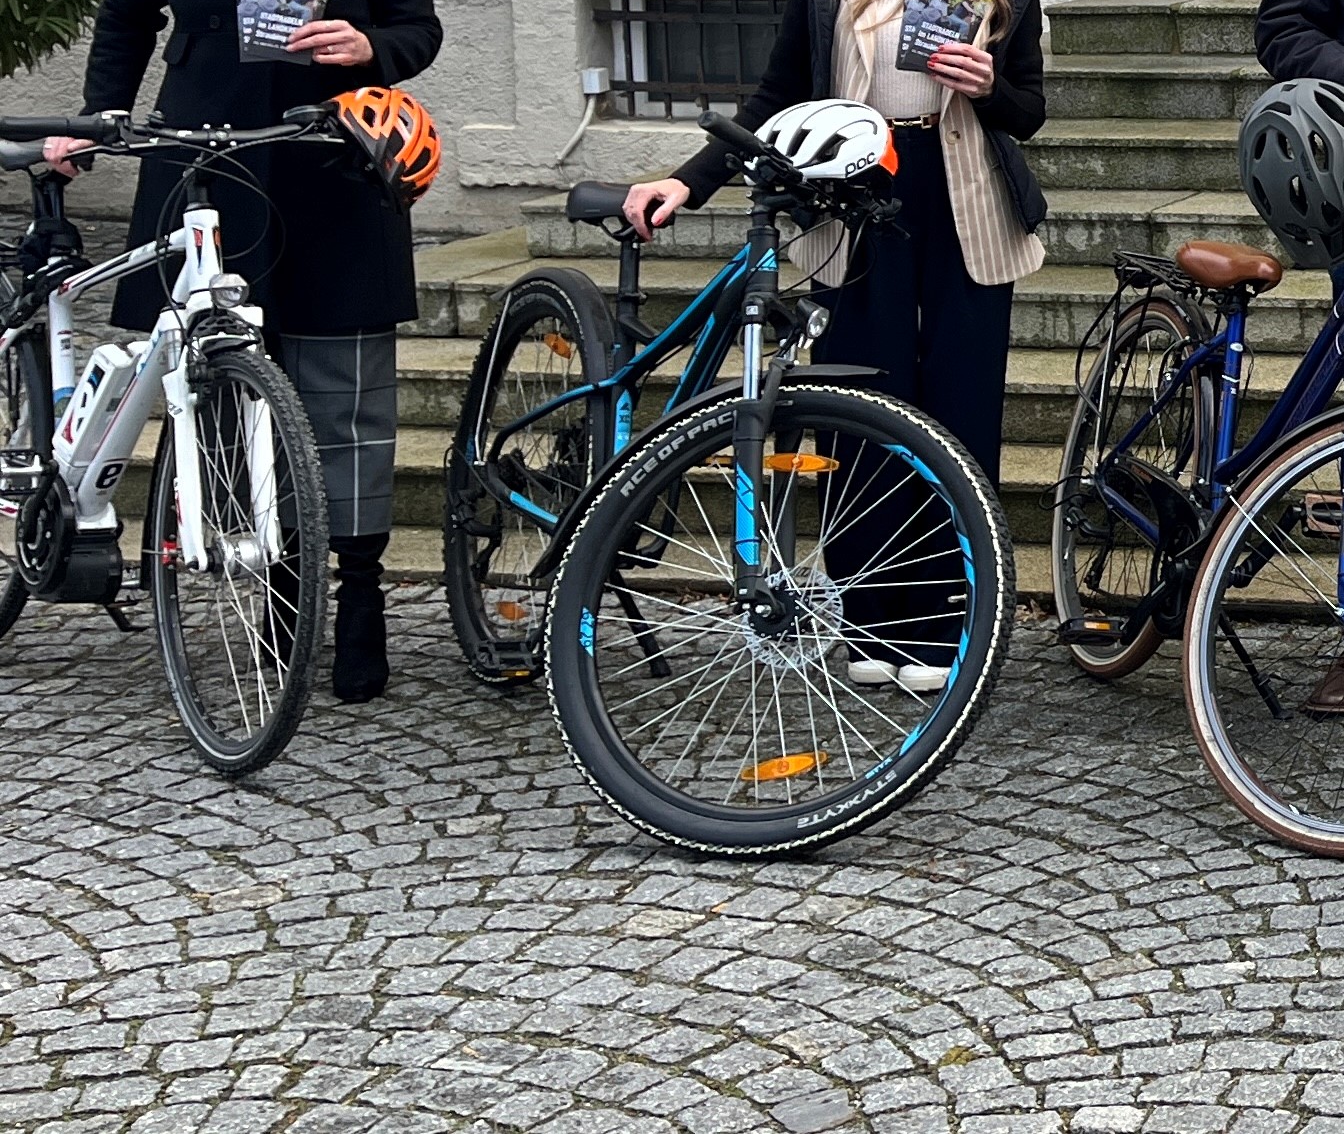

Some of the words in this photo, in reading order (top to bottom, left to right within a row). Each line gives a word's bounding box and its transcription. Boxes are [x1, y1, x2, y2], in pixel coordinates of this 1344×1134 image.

[845, 151, 876, 178] POC
[619, 458, 660, 498] ACE
[656, 434, 687, 461] OF
[686, 409, 738, 441] PAC
